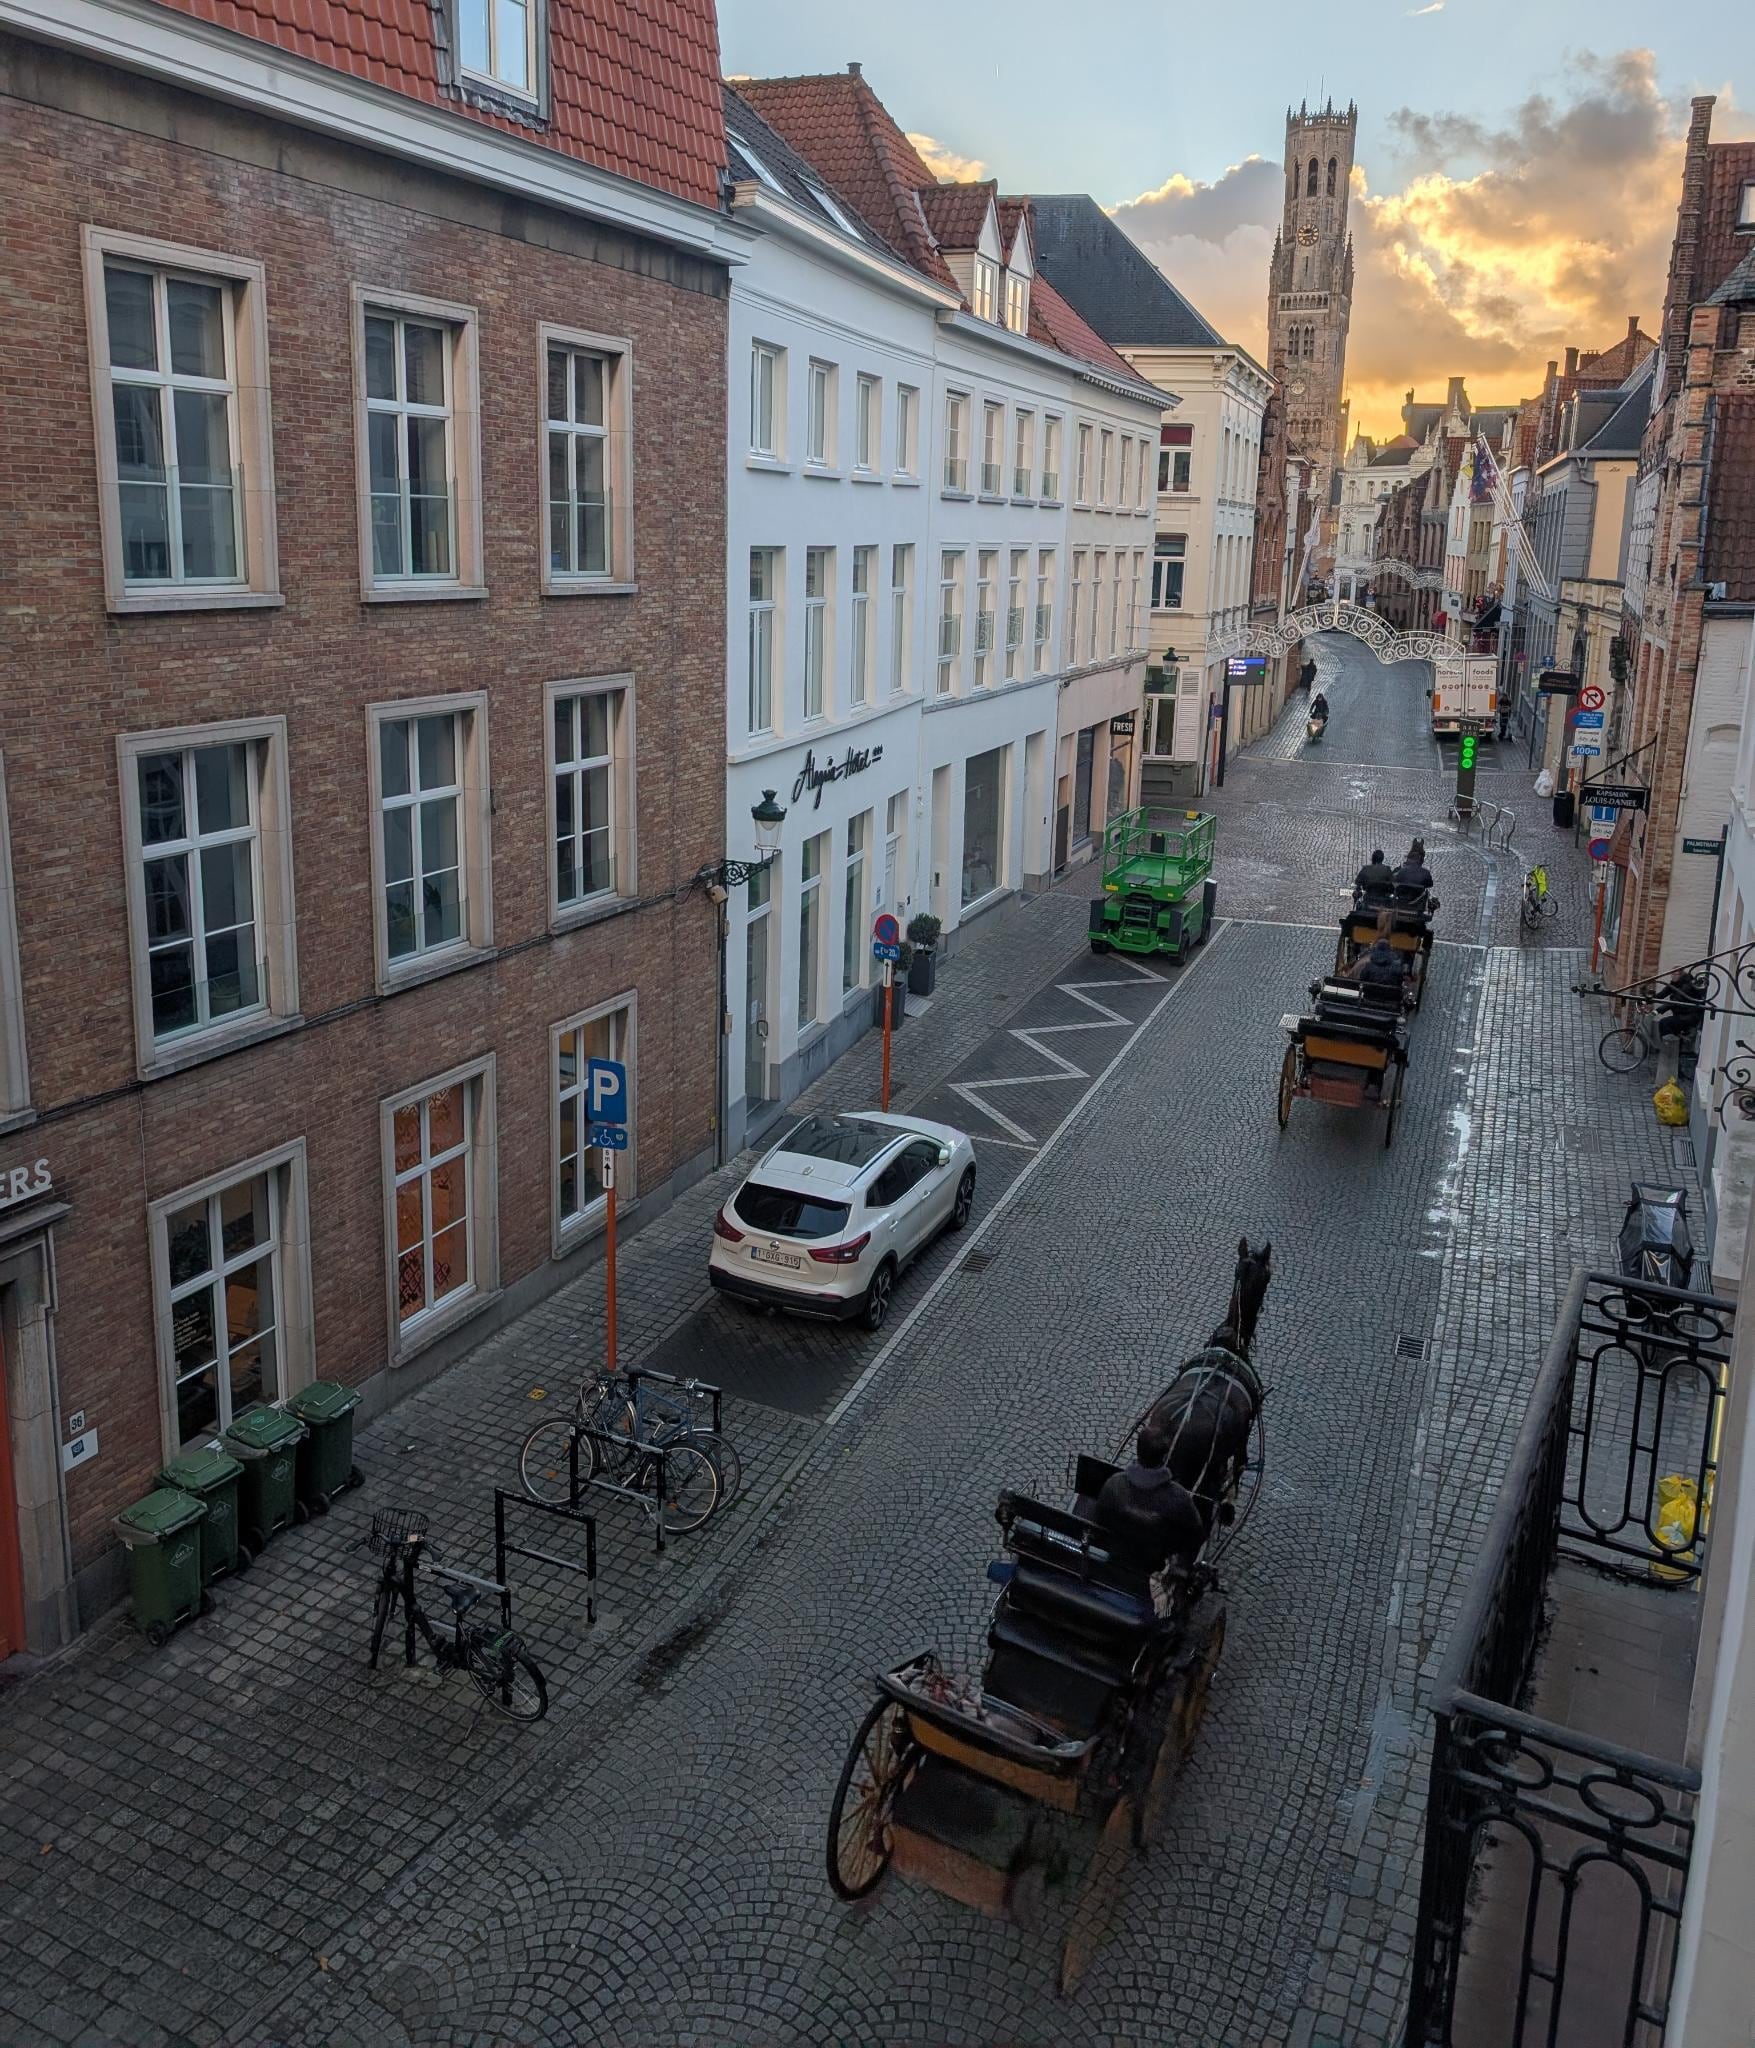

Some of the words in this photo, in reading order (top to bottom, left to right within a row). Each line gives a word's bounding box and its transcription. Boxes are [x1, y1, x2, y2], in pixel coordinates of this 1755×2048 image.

[1113, 721, 1133, 732] FRESH
[837, 746, 872, 779] Hotel
[1596, 789, 1629, 798] KAPSALON
[593, 1068, 619, 1112] P
[71, 1415, 83, 1430] 36
